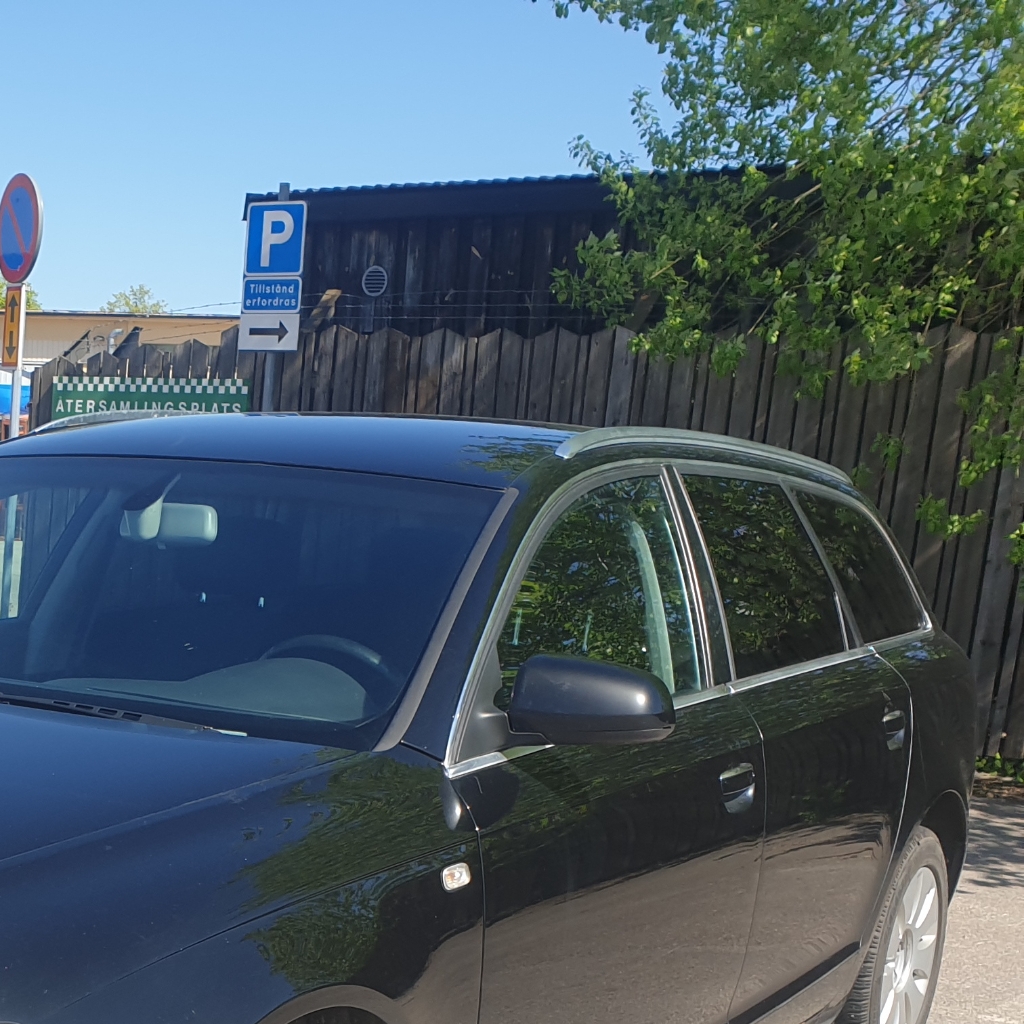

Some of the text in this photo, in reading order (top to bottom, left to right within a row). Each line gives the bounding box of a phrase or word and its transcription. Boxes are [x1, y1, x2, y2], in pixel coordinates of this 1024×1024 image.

[260, 210, 295, 268] P
[249, 283, 295, 294] Tillstånd
[245, 296, 297, 307] erfordras
